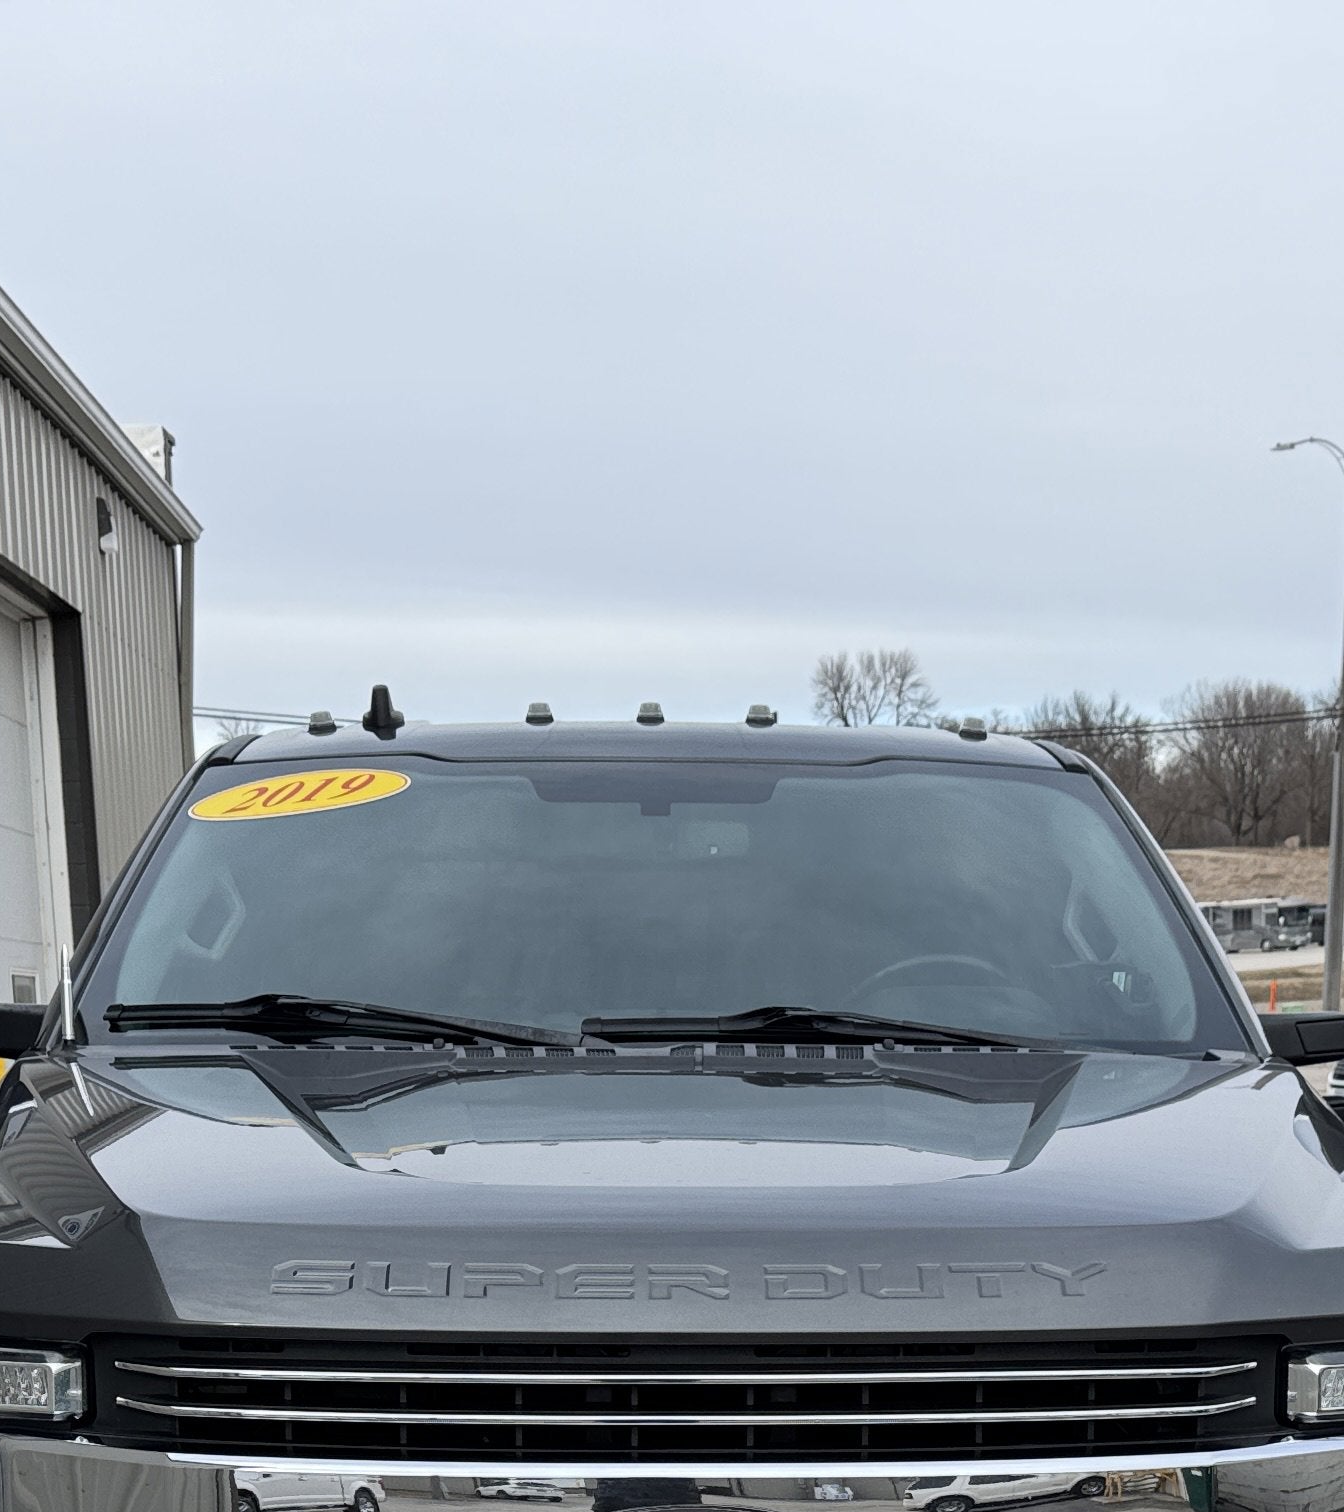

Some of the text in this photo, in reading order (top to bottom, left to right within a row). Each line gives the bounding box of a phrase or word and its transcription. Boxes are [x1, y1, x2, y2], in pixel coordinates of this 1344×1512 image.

[222, 774, 375, 814] 2019
[270, 1259, 1107, 1299] SUPER DUTY
